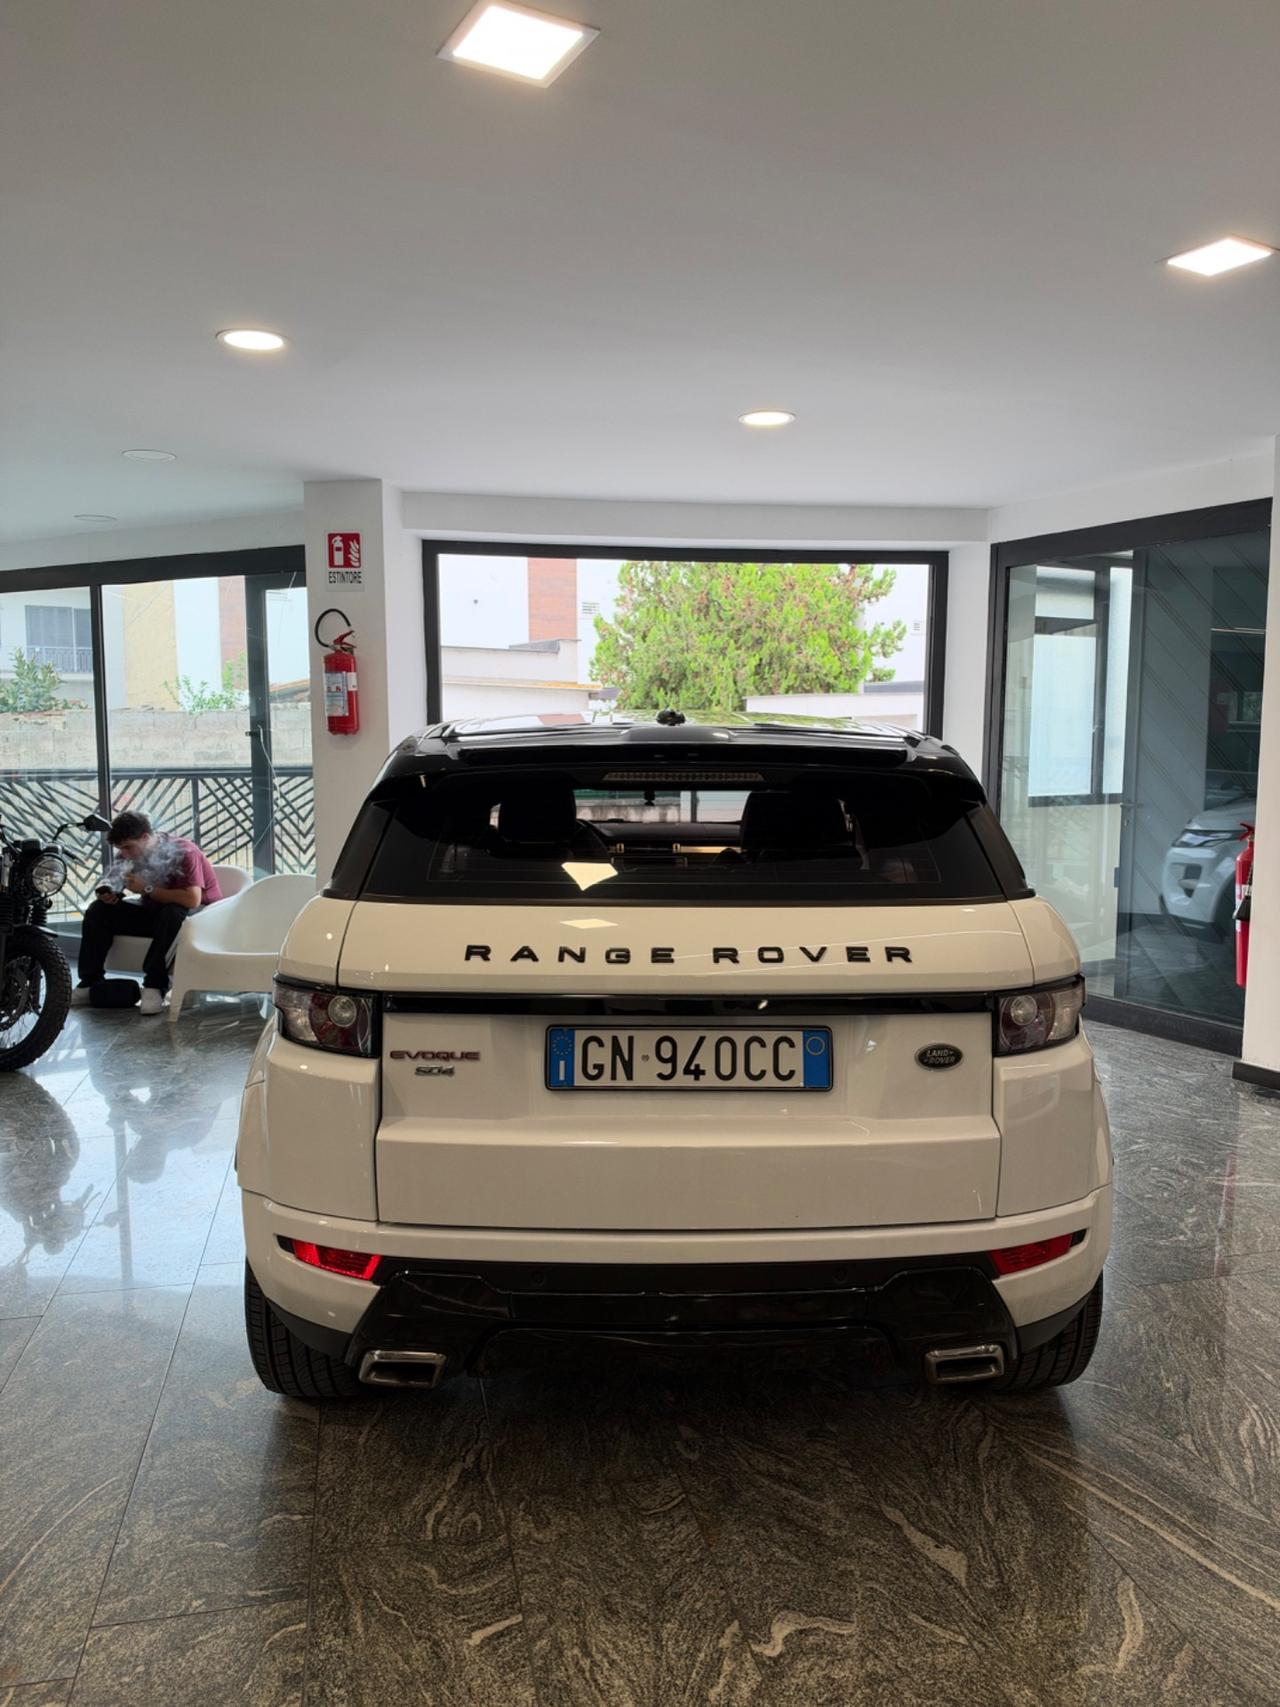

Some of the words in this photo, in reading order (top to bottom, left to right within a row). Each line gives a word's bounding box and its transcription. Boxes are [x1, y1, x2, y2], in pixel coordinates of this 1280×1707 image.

[328, 571, 362, 584] ESTINTORE
[464, 944, 675, 964] RANGE
[712, 946, 912, 964] ROVER
[390, 1050, 481, 1061] EVOQUE
